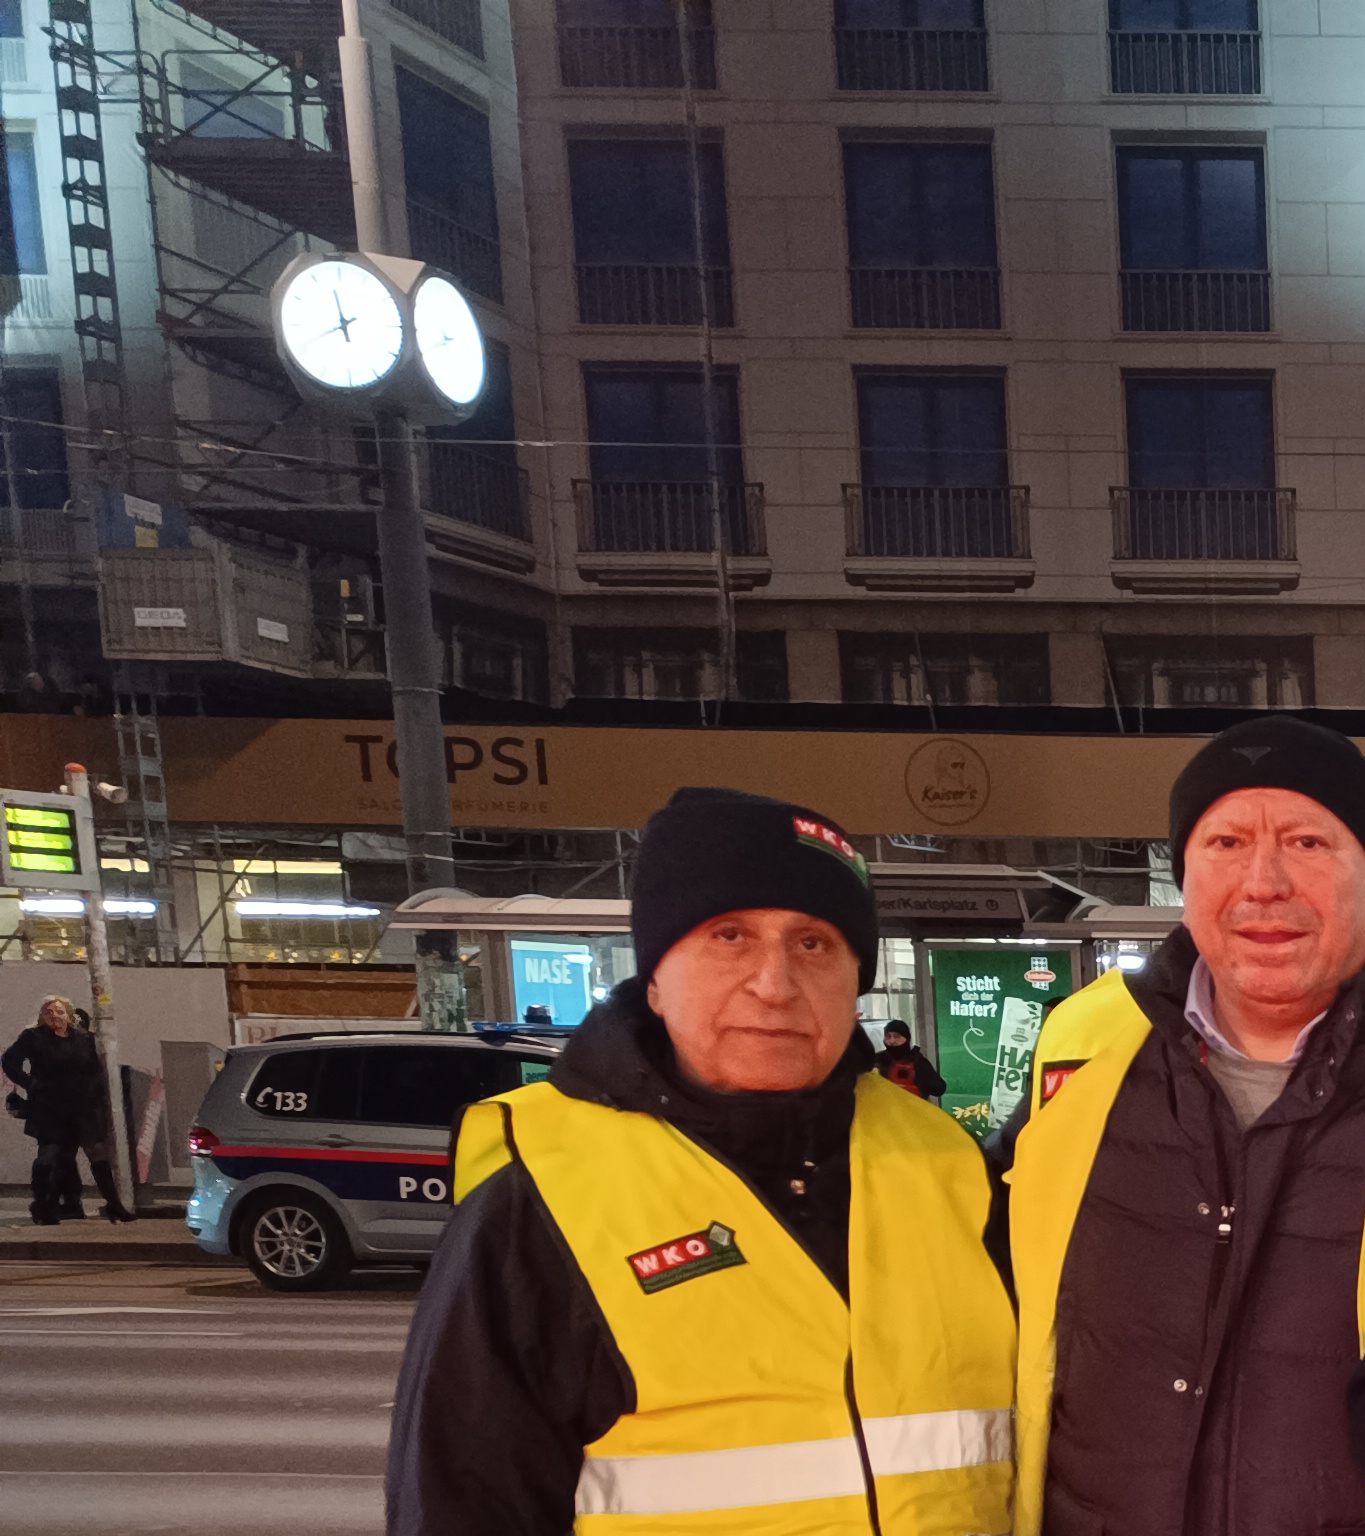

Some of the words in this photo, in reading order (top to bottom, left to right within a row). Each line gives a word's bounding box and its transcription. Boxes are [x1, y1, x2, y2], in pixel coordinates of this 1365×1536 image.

[796, 819, 855, 858] WKO
[525, 957, 573, 985] NASE
[956, 975, 1001, 992] Sticht
[950, 1000, 998, 1018] Hafer?
[273, 1091, 308, 1112] 133
[400, 1176, 447, 1201] PO
[633, 1239, 706, 1274] WKO
